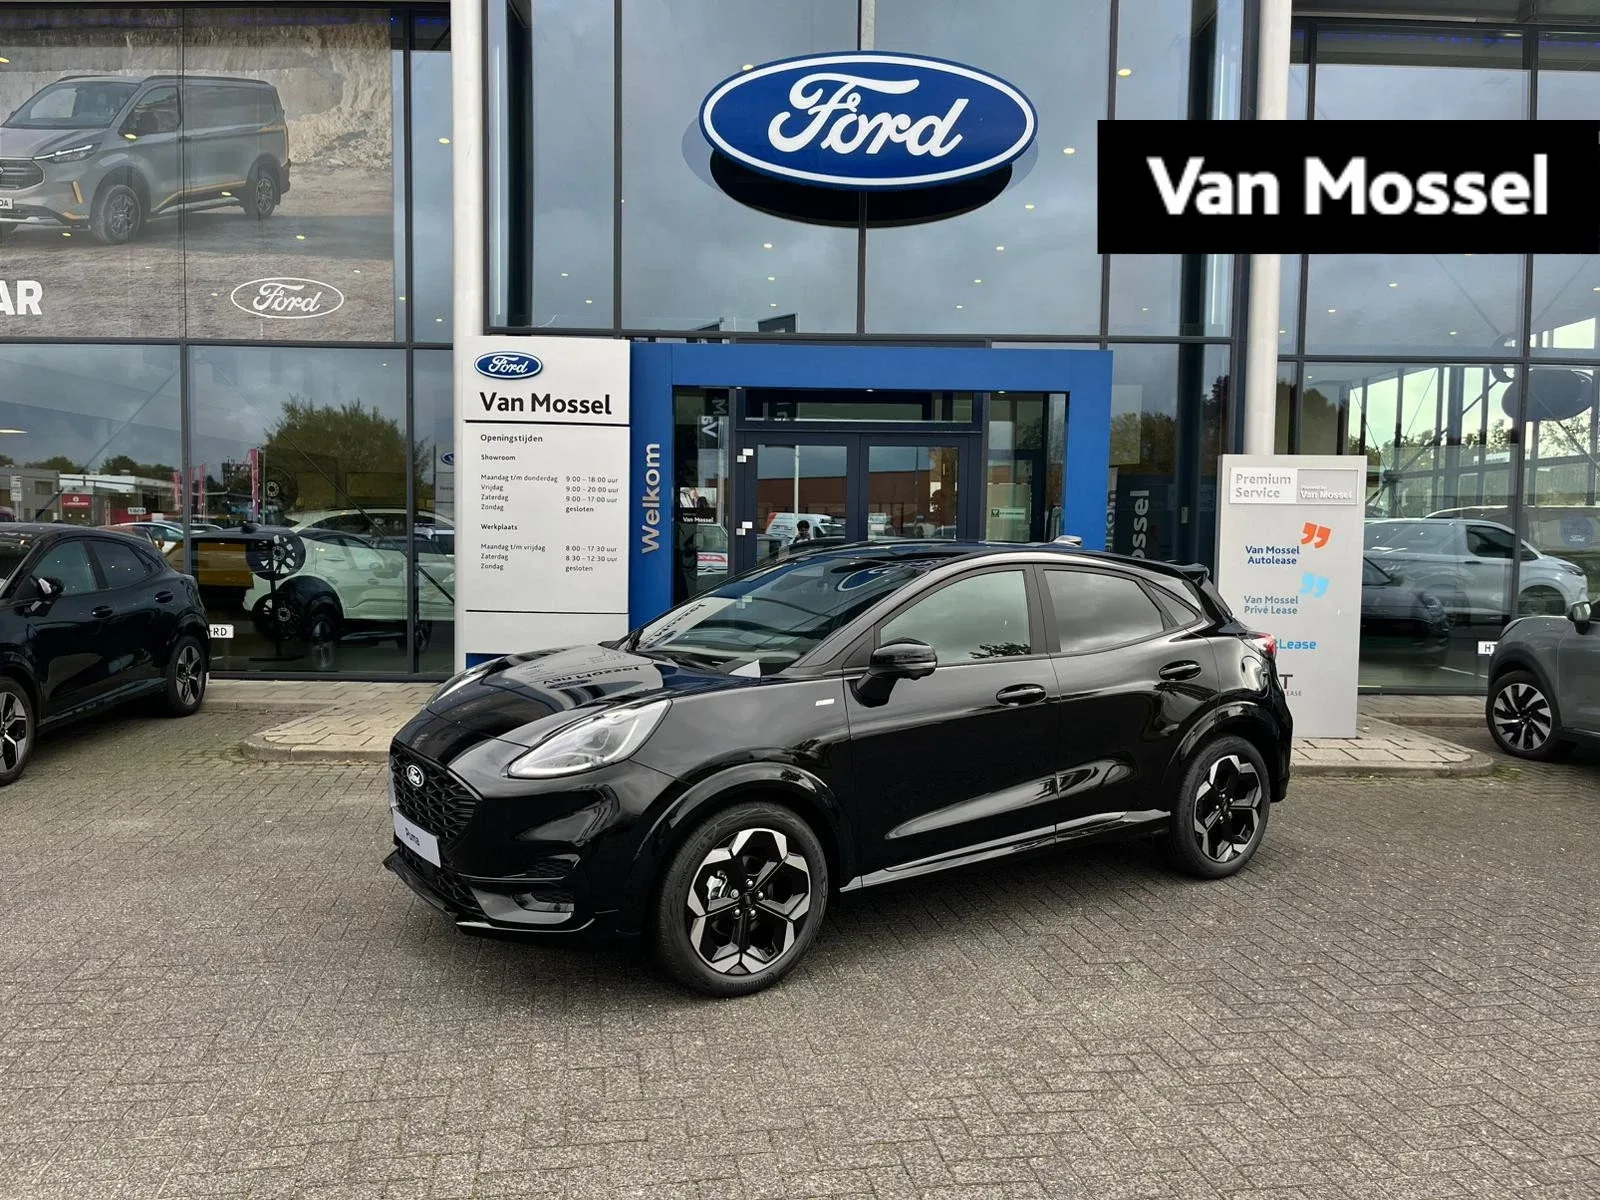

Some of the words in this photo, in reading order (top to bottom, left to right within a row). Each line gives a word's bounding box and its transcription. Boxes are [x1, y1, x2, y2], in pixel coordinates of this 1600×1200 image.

[767, 72, 970, 158] Ford
[252, 282, 322, 313] Ford
[488, 355, 529, 374] Ford
[479, 391, 524, 412] Van
[531, 393, 612, 415] Mossel
[480, 434, 543, 444] Openingstijden
[480, 474, 509, 482] Maandag
[523, 474, 558, 483] donderdag
[1235, 473, 1291, 485] Premium
[480, 484, 504, 492] Vrijdag
[1235, 487, 1280, 498] Service
[480, 493, 509, 502] Zaterdag
[641, 443, 661, 553] Welkom
[1301, 490, 1318, 499] Van
[1319, 490, 1353, 500] Mossel
[480, 503, 505, 512] Zondag
[565, 505, 595, 513] gesloten
[480, 523, 518, 531] Werkplaats
[480, 543, 509, 551] Maandag
[523, 544, 546, 552] vrijdag
[1245, 545, 1263, 554] Van
[1265, 545, 1300, 554] Mossel
[480, 553, 509, 562] Zaterdag
[1247, 555, 1297, 565] Autolease
[480, 563, 505, 571] Zondag
[565, 564, 594, 573] gesloten
[1244, 595, 1262, 604] Van
[1264, 595, 1299, 604] Mossel
[1244, 605, 1269, 614] Privé
[1270, 606, 1298, 614] Lease
